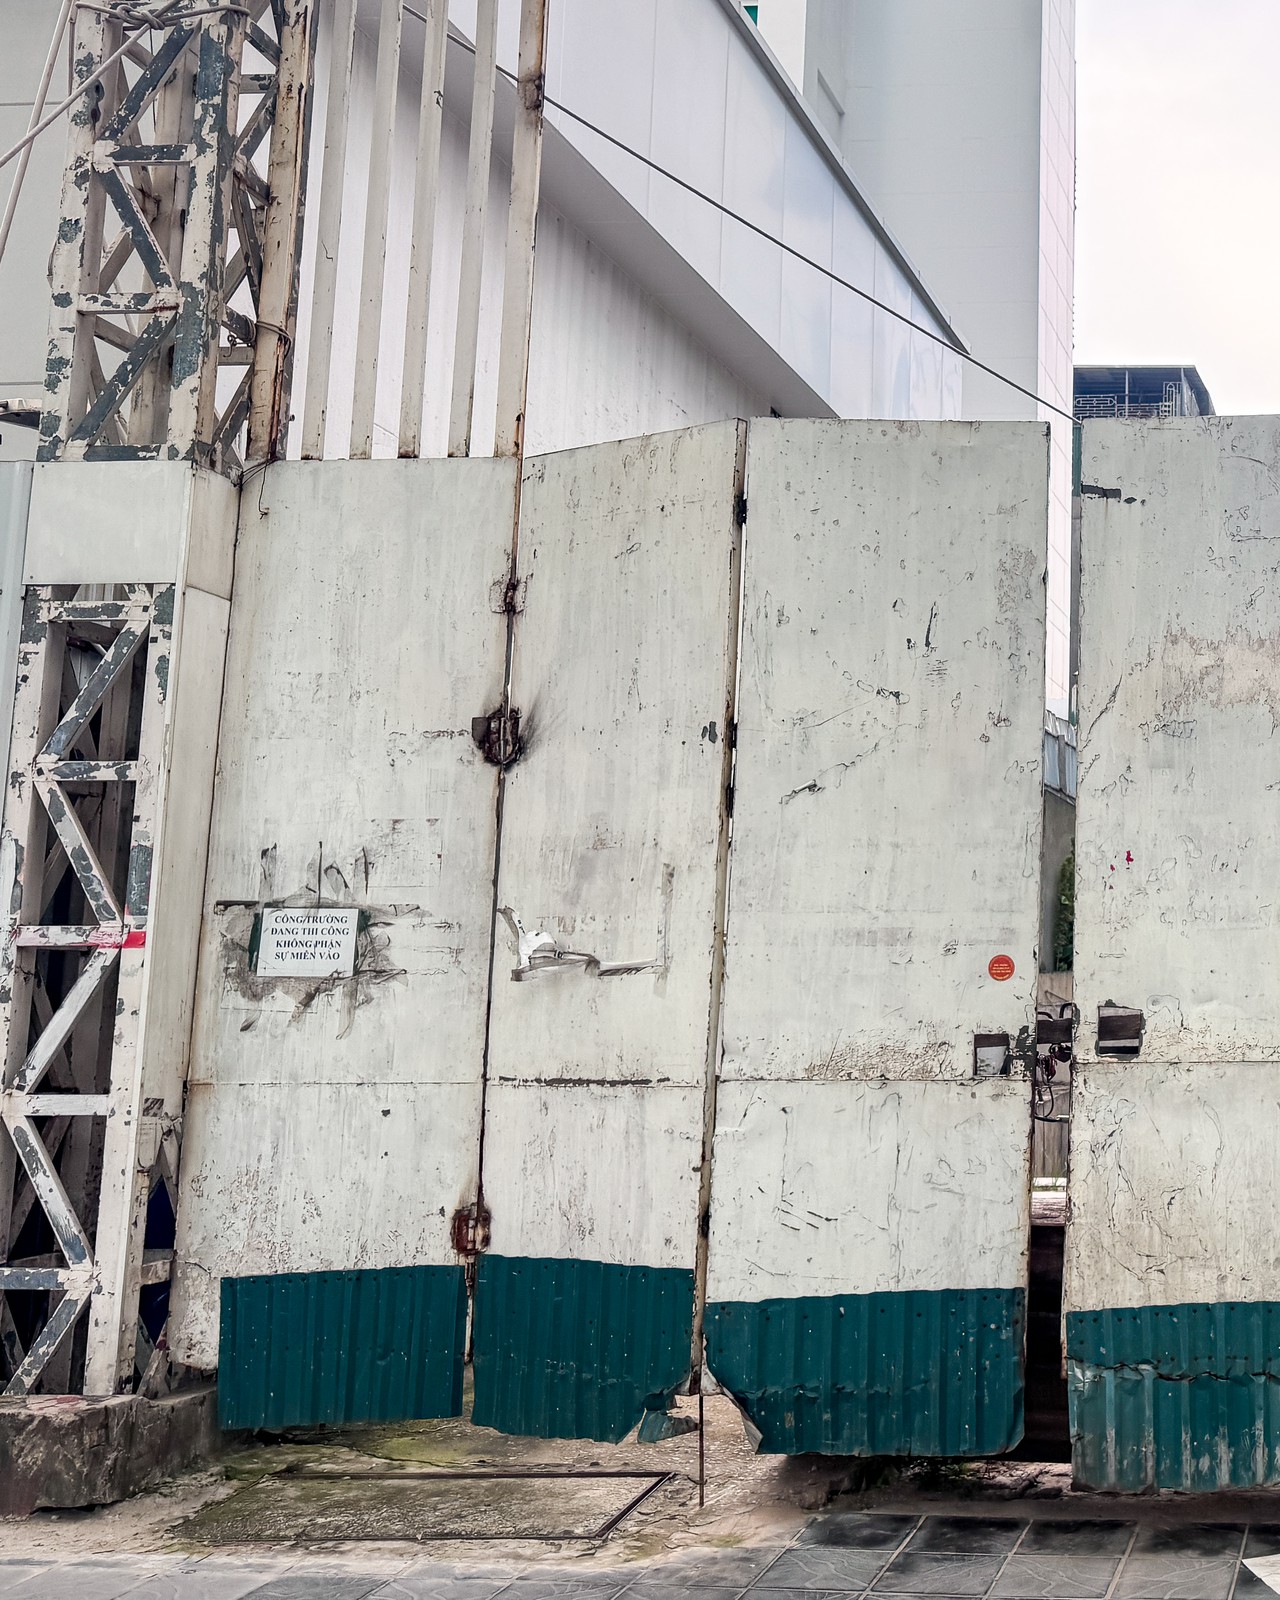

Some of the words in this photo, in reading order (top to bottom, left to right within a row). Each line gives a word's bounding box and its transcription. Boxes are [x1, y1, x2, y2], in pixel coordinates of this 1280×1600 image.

[274, 914, 303, 924] CÔNG
[306, 914, 348, 924] TRƯỜNG
[301, 927, 318, 936] THI
[320, 926, 350, 936] CÔNG
[276, 938, 313, 948] KHÔNG
[319, 950, 340, 960] VÀO
